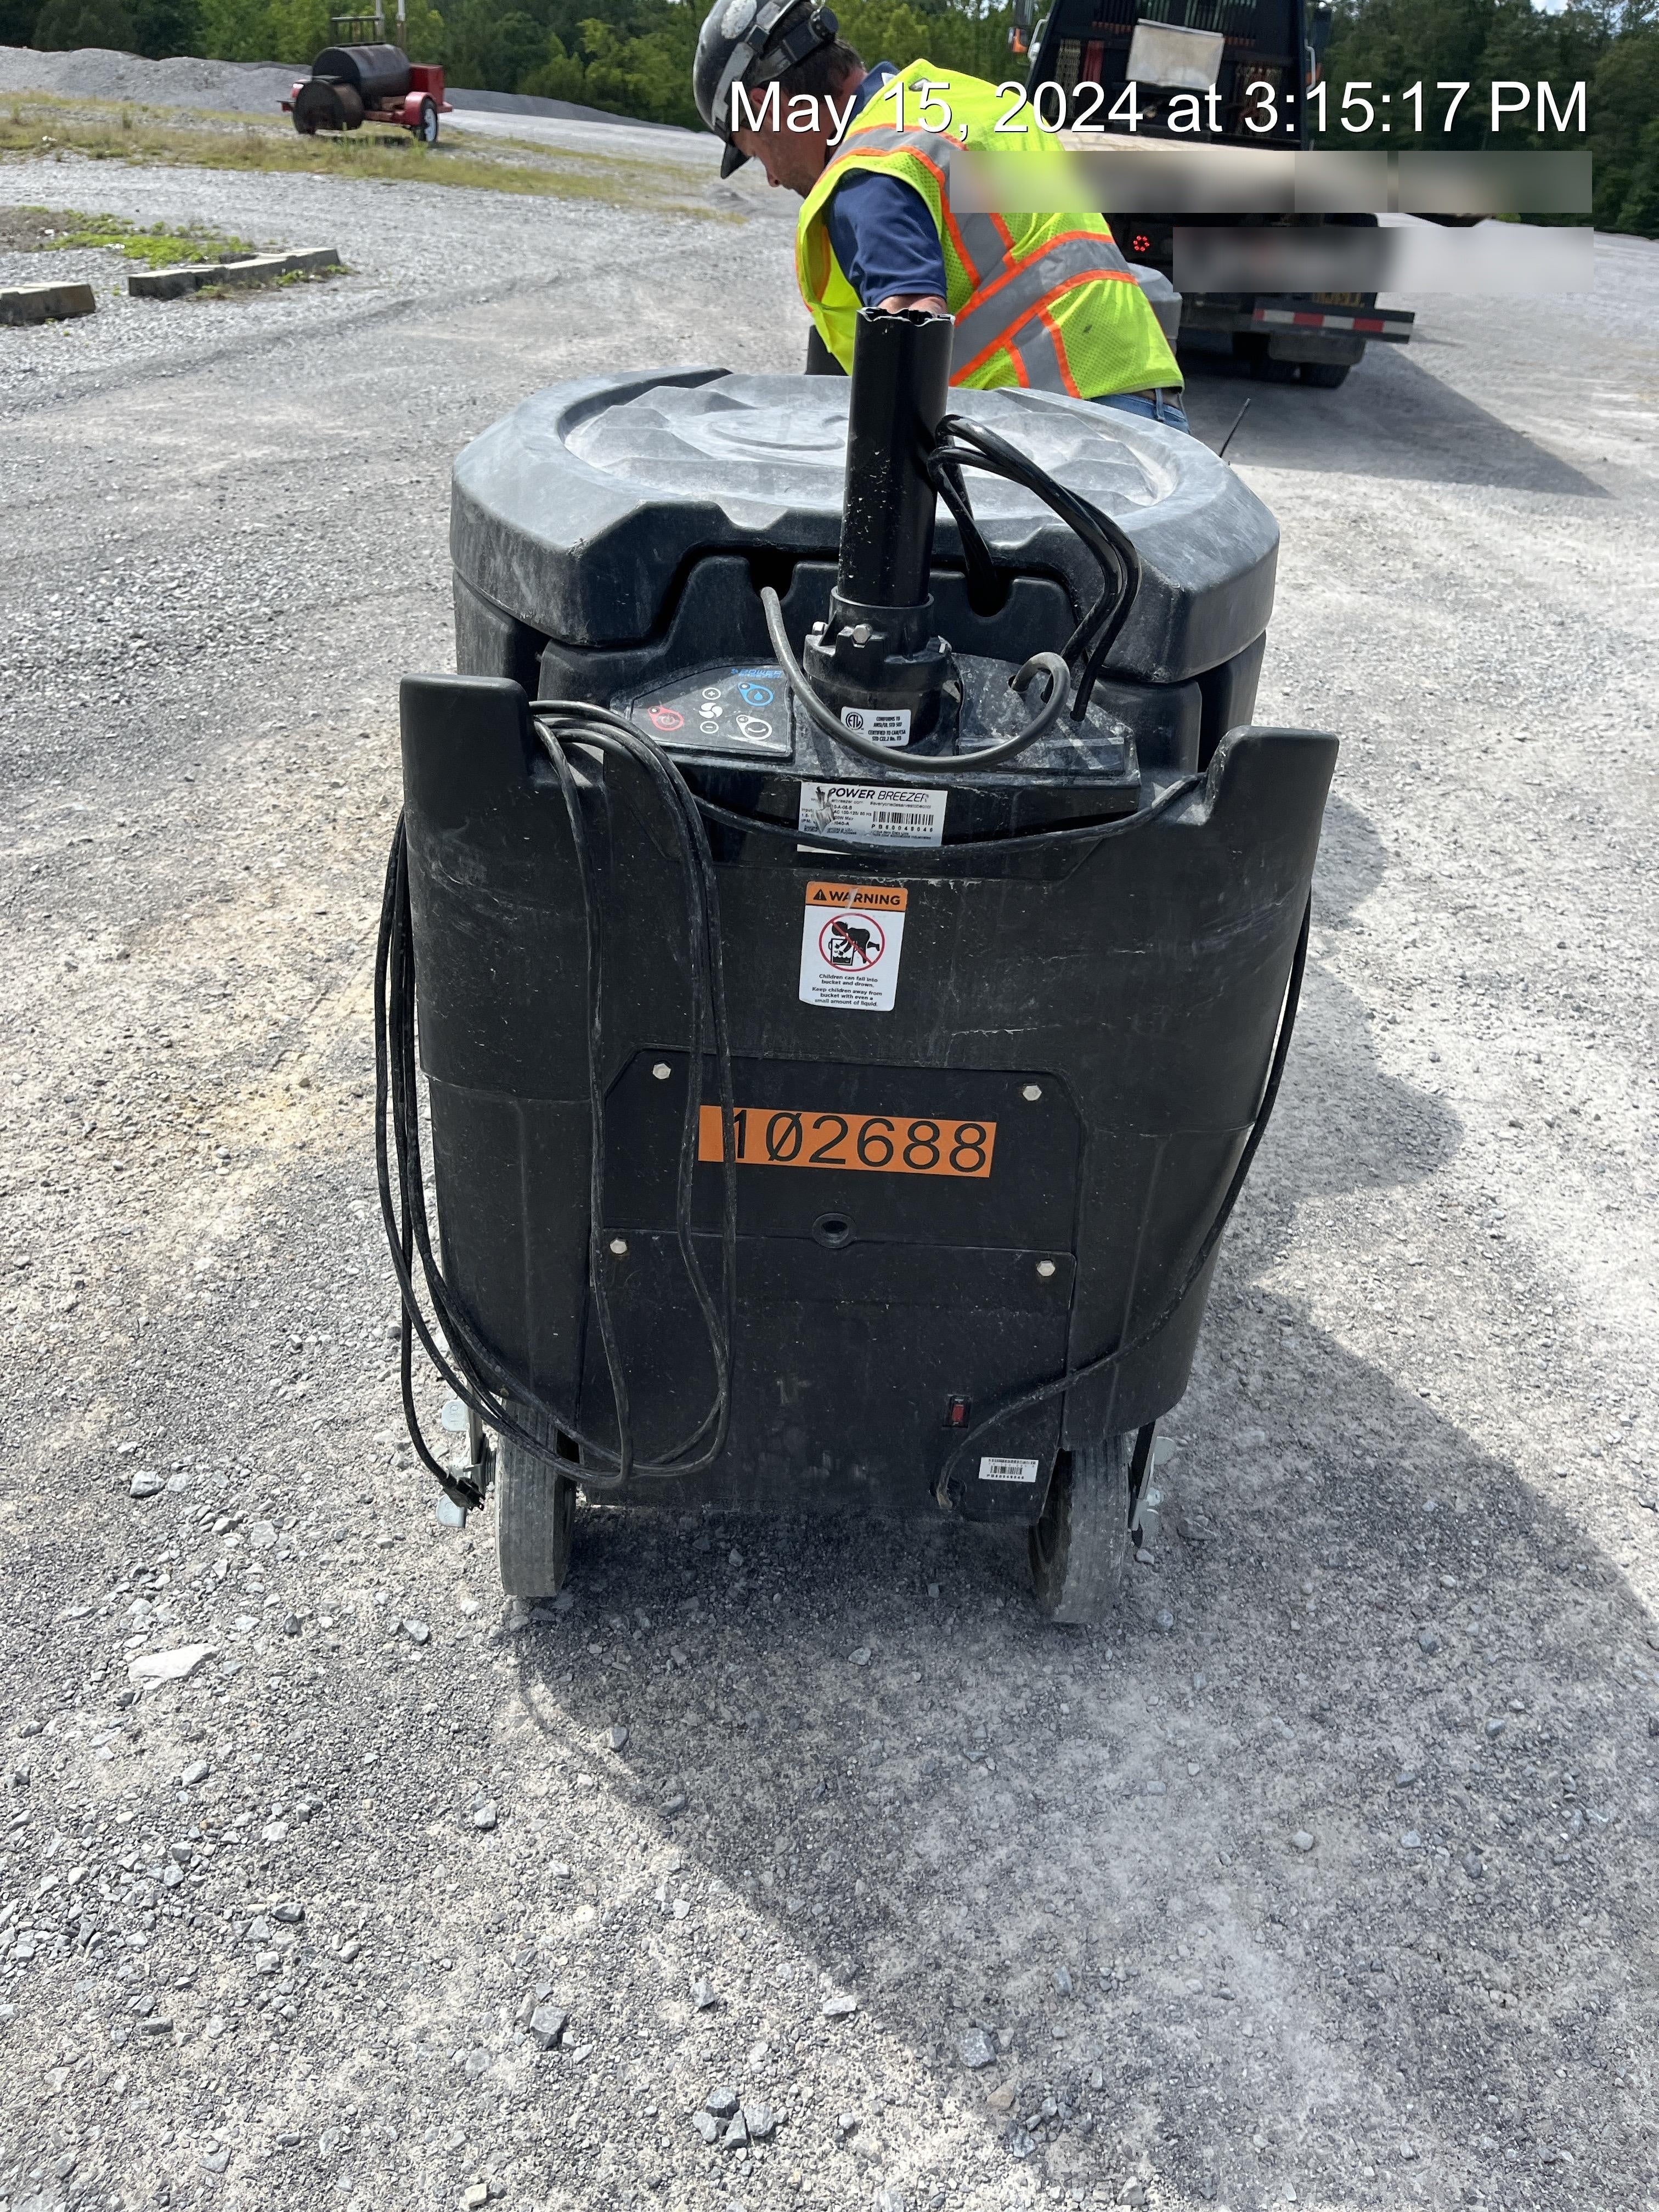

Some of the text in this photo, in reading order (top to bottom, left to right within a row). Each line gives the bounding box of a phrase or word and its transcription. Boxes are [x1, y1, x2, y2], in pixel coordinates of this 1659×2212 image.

[827, 788, 928, 802] POWER BREEZER
[830, 890, 900, 905] WARNING
[732, 1109, 987, 1172] 102688
